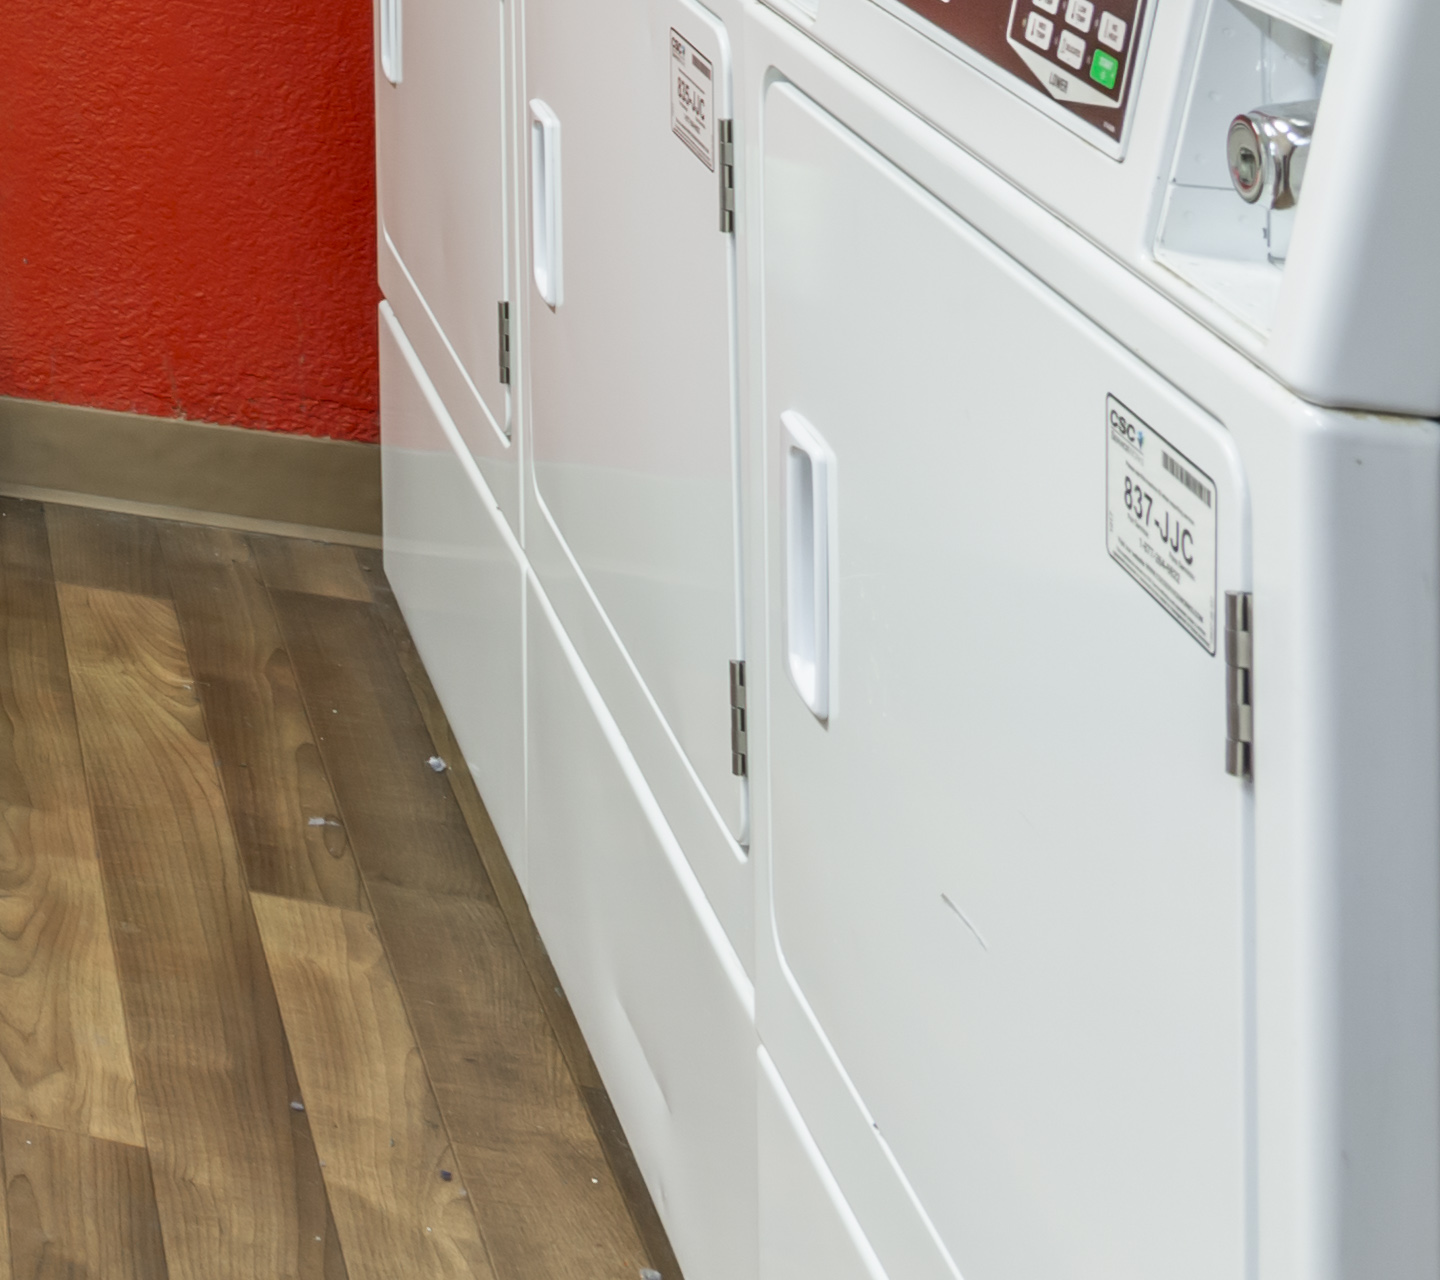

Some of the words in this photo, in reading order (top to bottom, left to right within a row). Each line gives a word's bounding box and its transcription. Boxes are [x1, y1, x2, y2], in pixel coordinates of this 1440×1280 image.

[1048, 71, 1069, 94] LOWER
[1110, 409, 1136, 442] CSC
[1124, 475, 1194, 566] 837-JJC
